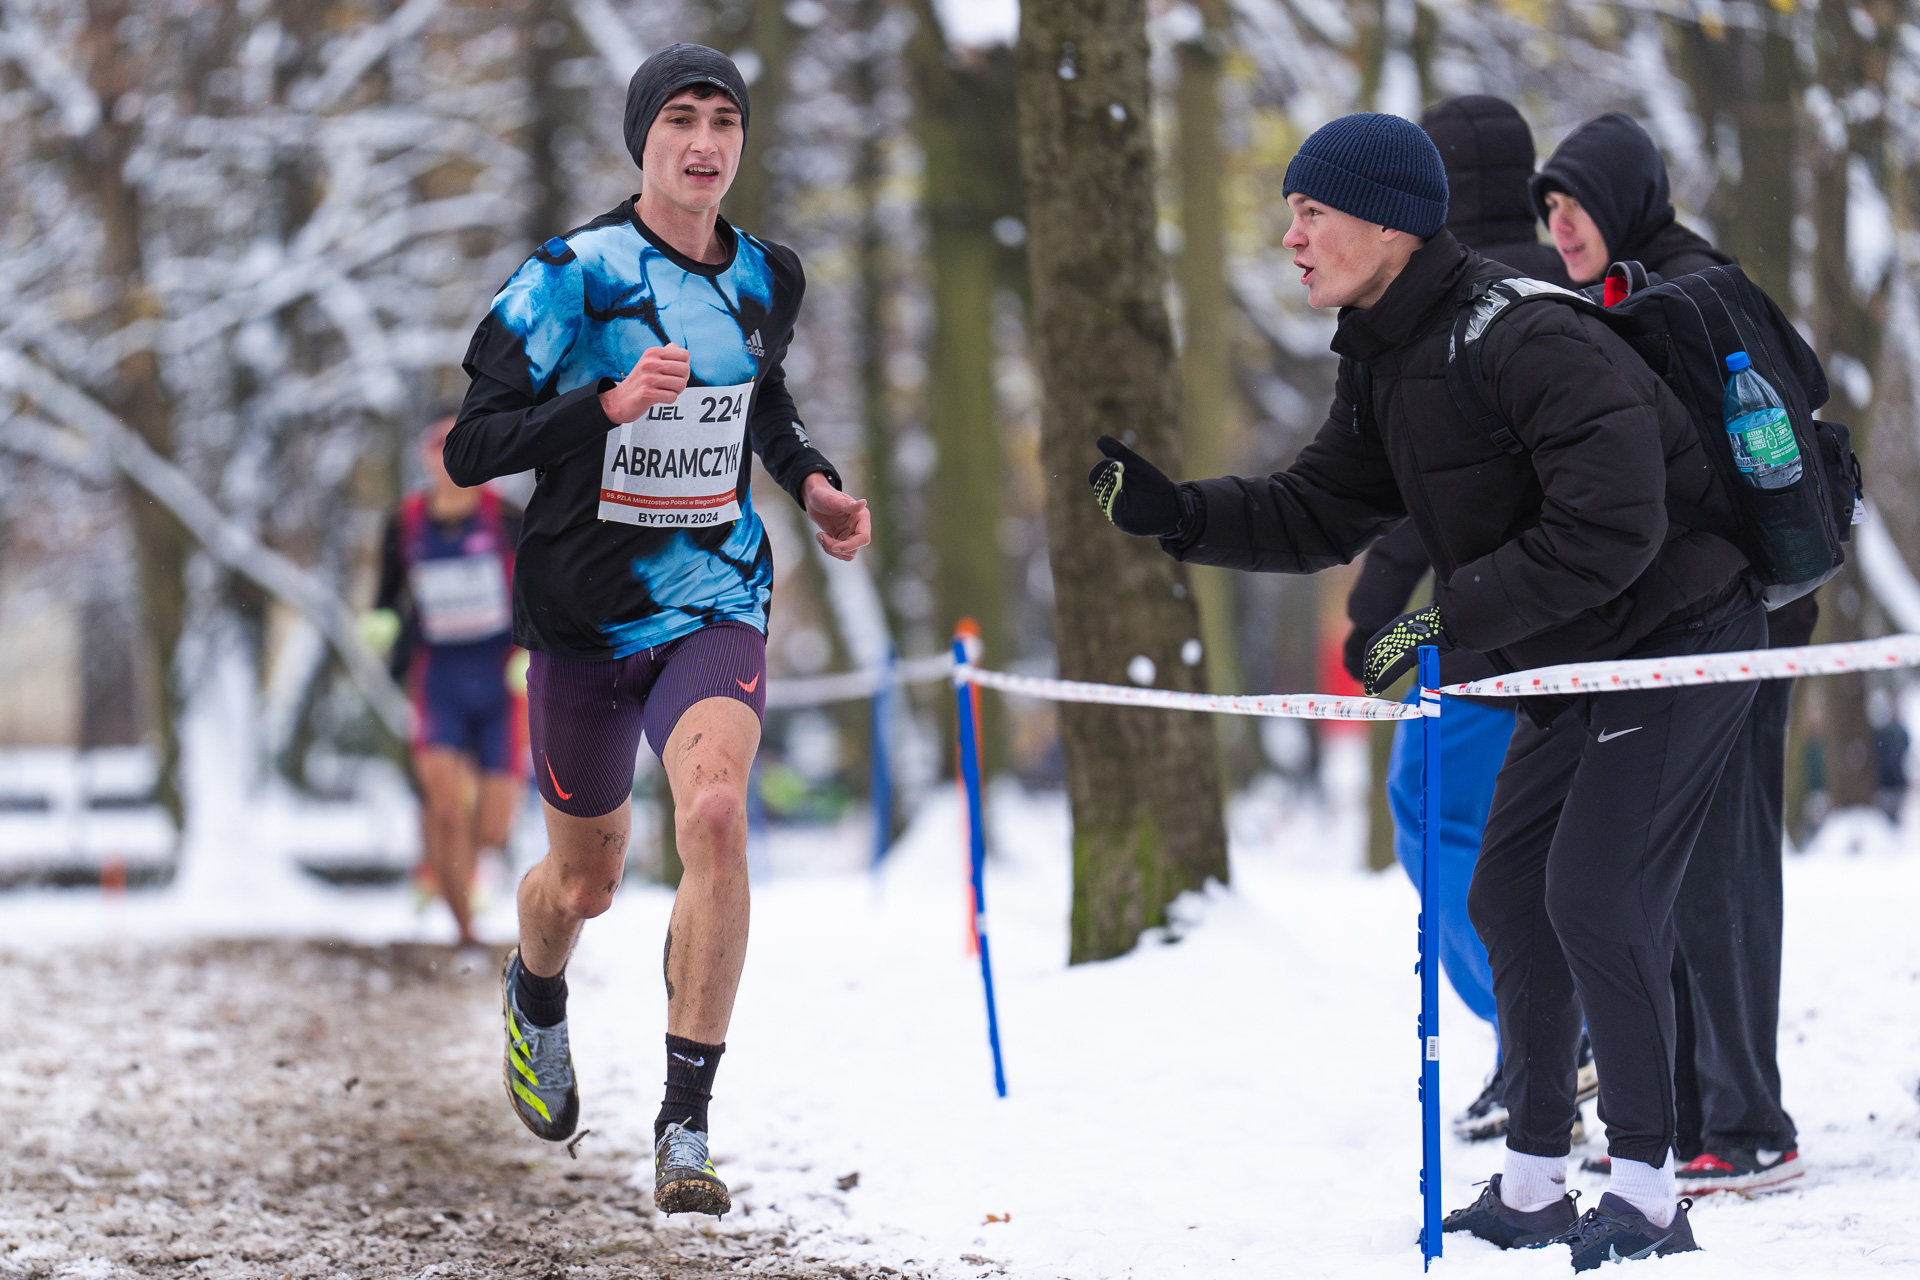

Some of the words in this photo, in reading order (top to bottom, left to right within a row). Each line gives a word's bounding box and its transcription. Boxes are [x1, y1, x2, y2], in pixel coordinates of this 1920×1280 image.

[742, 345, 765, 357] adidas
[699, 393, 743, 423] 224
[611, 442, 740, 478] ABRAMCZYK
[616, 494, 632, 502] PZLA
[632, 497, 670, 506] Mistrzostwa
[638, 512, 688, 524] BYTOM
[690, 511, 719, 524] 2024
